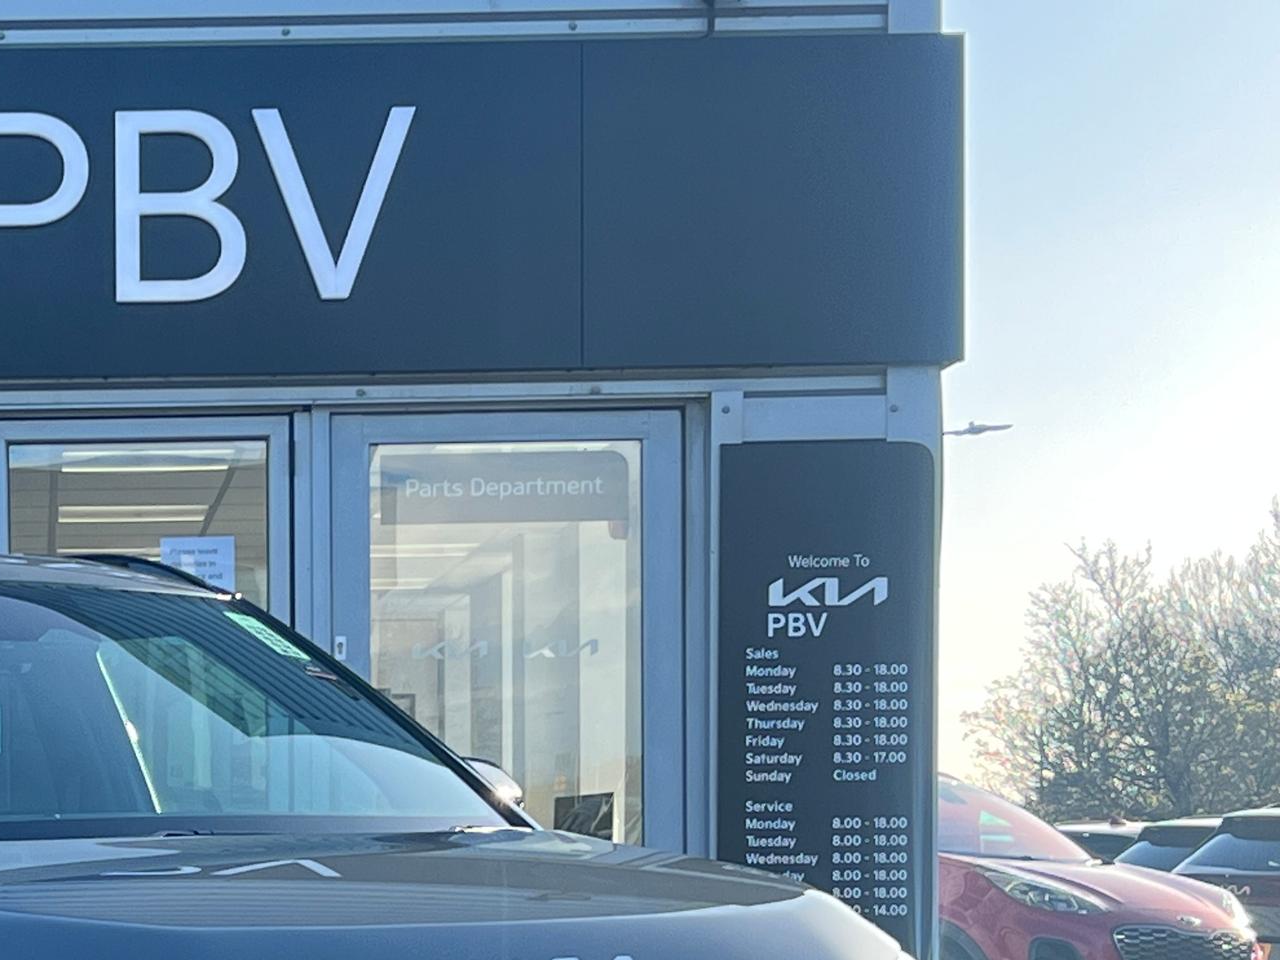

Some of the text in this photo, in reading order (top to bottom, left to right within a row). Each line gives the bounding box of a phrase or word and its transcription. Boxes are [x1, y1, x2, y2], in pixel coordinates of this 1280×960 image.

[405, 476, 604, 500] Parts Department
[788, 554, 870, 568] Welcome To
[768, 576, 888, 606] KIA
[767, 612, 828, 637] PBV
[746, 648, 779, 660] Sales
[746, 665, 796, 680] Monday
[833, 664, 862, 675] 8.30
[873, 664, 908, 675] 18.00
[746, 683, 796, 697] Tuesday
[833, 682, 862, 693] 8.30
[873, 682, 908, 693] 18.00
[746, 700, 819, 714] Wednesday
[833, 699, 862, 710] 8.30
[873, 699, 908, 710] 18.00
[746, 718, 805, 731] Thursday
[833, 717, 862, 728] 8.30
[873, 717, 908, 728] 18.00
[746, 736, 785, 749] Friday
[833, 735, 862, 746] 8.30
[873, 735, 908, 746] 18.00
[746, 753, 802, 767] Saturday
[833, 752, 862, 763] 8.30
[873, 752, 906, 763] 17.00
[746, 770, 792, 784] Sunday
[833, 769, 877, 781] Closed
[746, 800, 793, 813] Service
[746, 818, 796, 832] Monday
[832, 817, 862, 829] 8.00
[873, 817, 908, 829] 18.00
[746, 836, 796, 849] Tuesday
[832, 835, 862, 846] 8.00
[873, 835, 908, 846] 18.00
[746, 853, 818, 866] Wednesday
[832, 852, 862, 864] 8.00
[873, 852, 908, 864] 18.00
[832, 870, 862, 881] 8.00
[873, 870, 908, 881] 18.00
[873, 887, 908, 899] 18.00
[873, 904, 908, 916] 14.00
